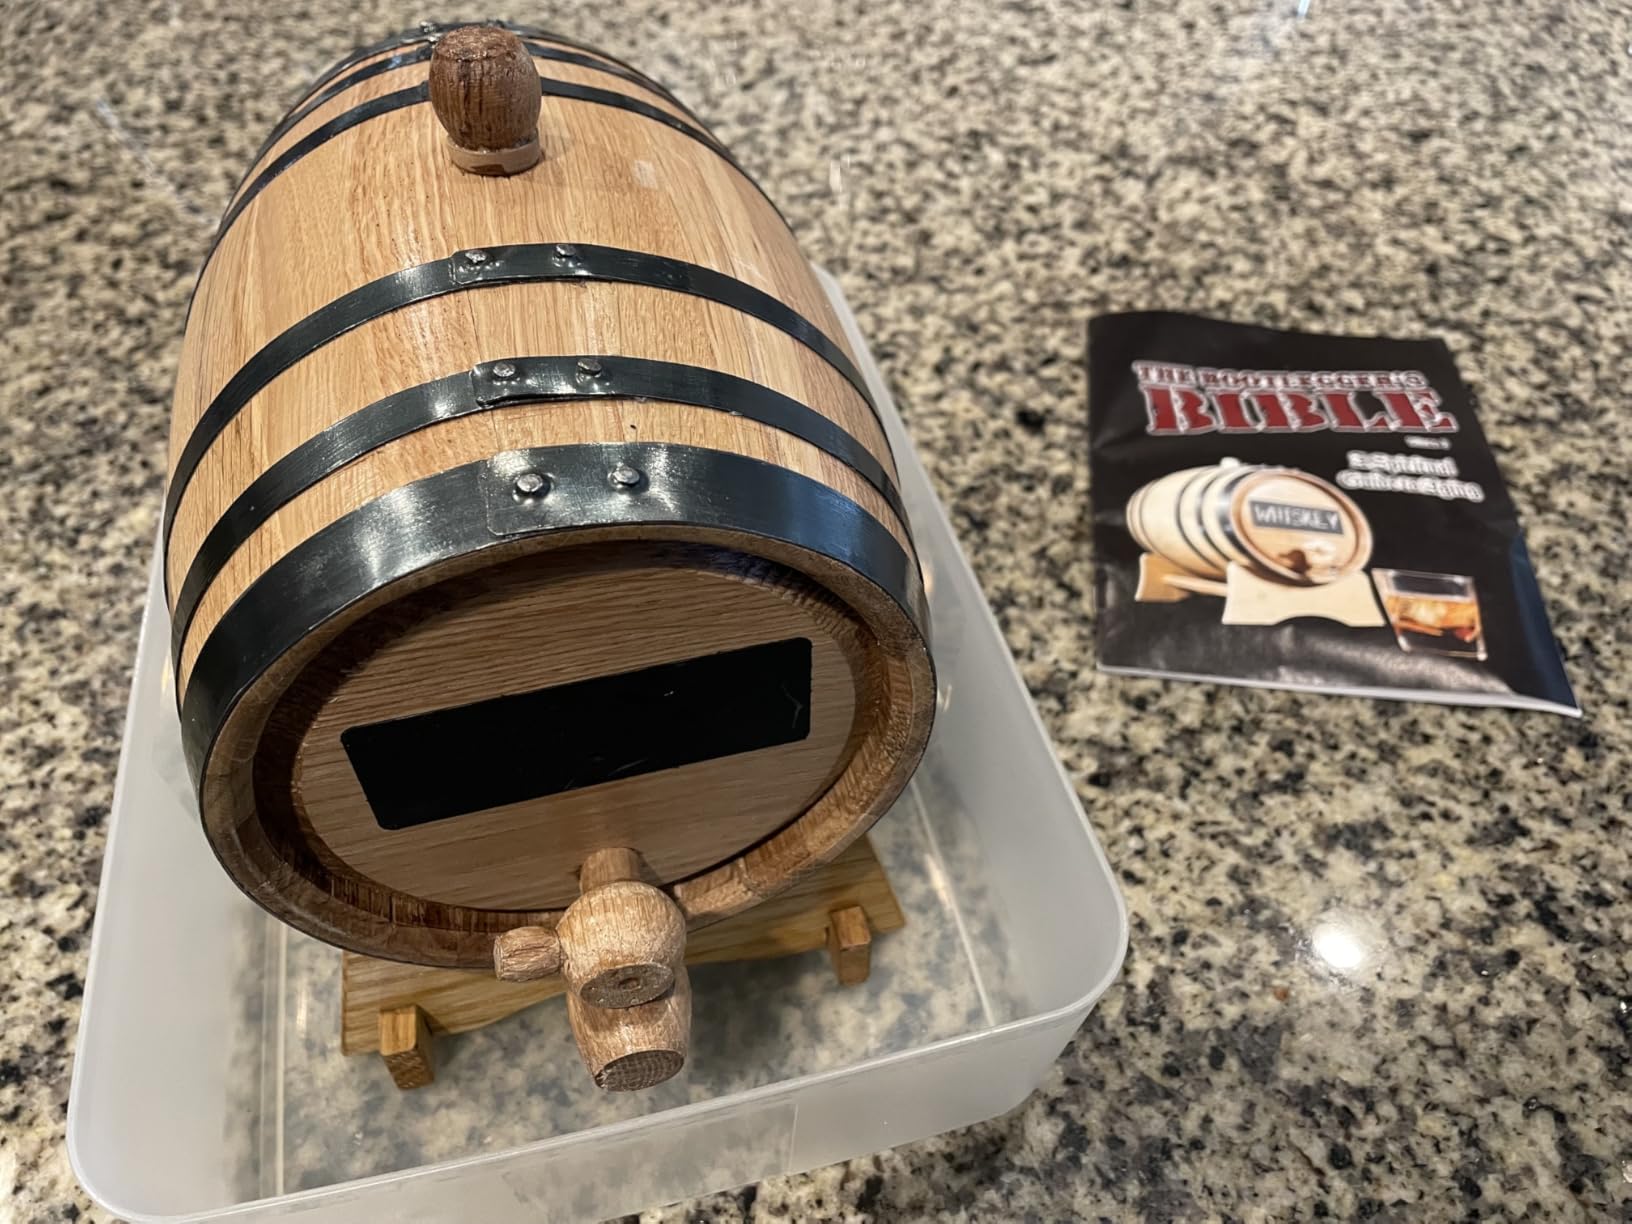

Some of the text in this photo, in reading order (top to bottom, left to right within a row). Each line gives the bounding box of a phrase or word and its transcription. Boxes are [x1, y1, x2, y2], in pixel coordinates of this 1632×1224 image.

[1132, 361, 1197, 385] THE
[1145, 385, 1459, 435] BIBLE
[1253, 503, 1340, 531] WHISKEY
